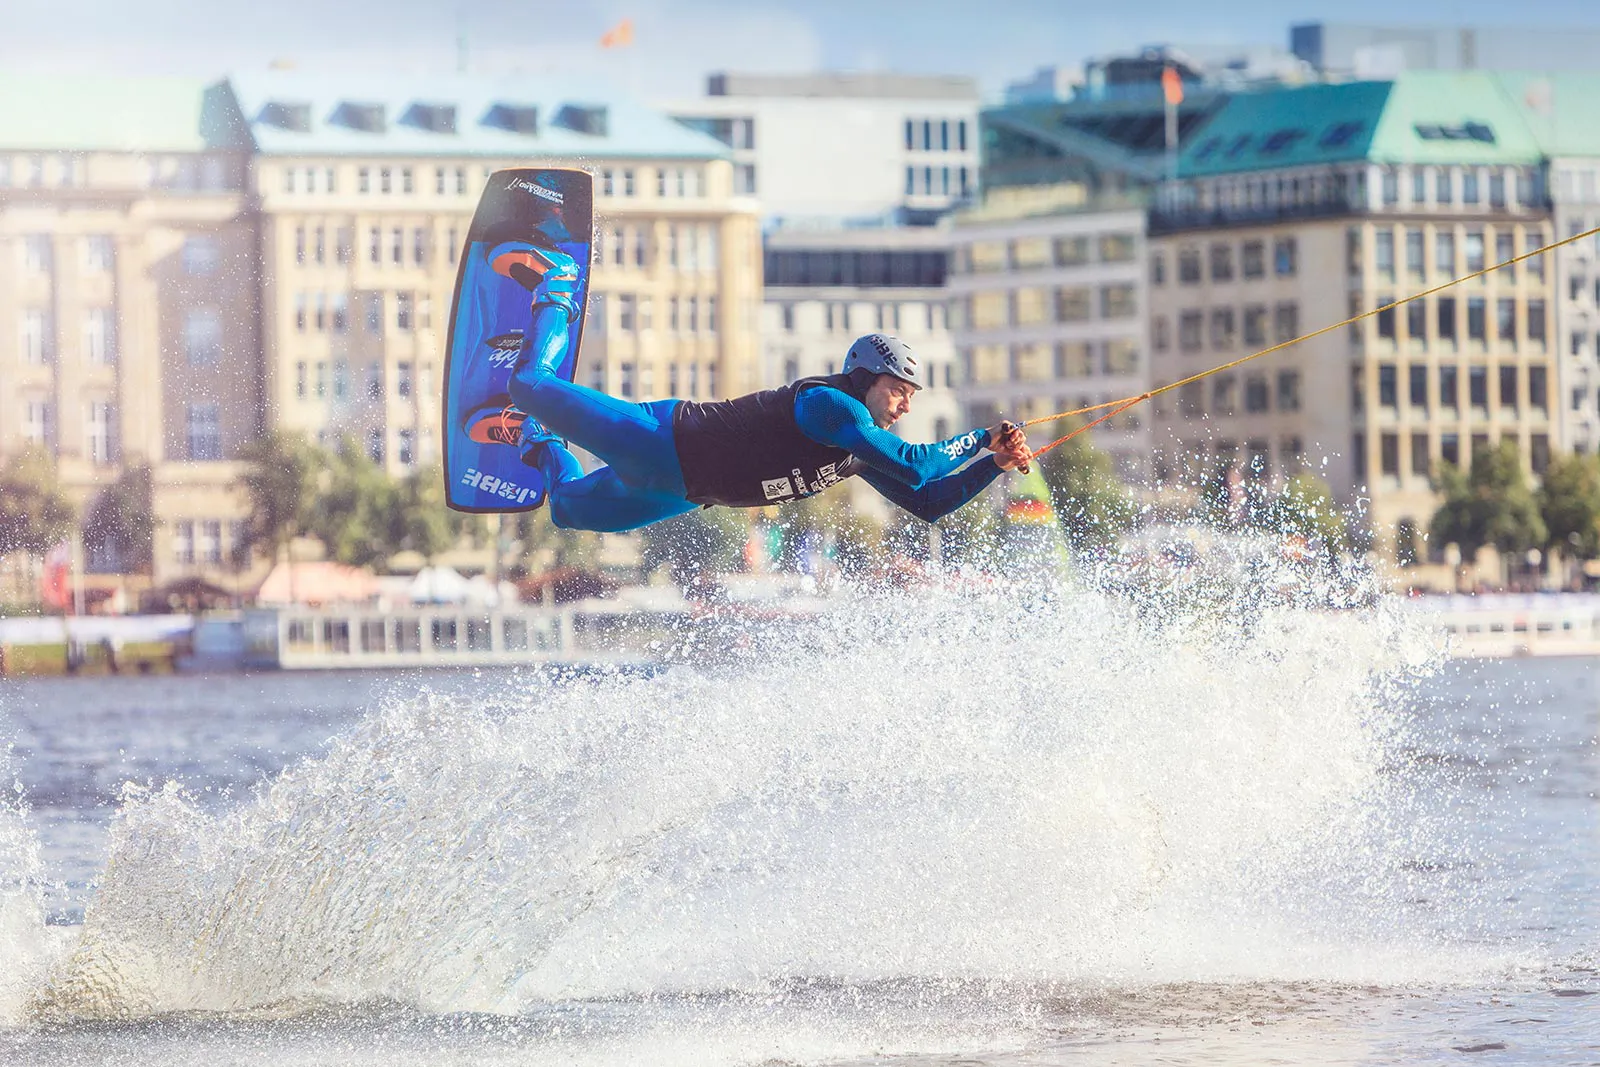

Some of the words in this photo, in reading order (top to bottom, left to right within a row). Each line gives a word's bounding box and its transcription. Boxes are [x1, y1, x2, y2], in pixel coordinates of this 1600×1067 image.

[942, 431, 977, 461] JOBE
[461, 468, 537, 503] JOBE
[792, 468, 808, 494] G-SHO
